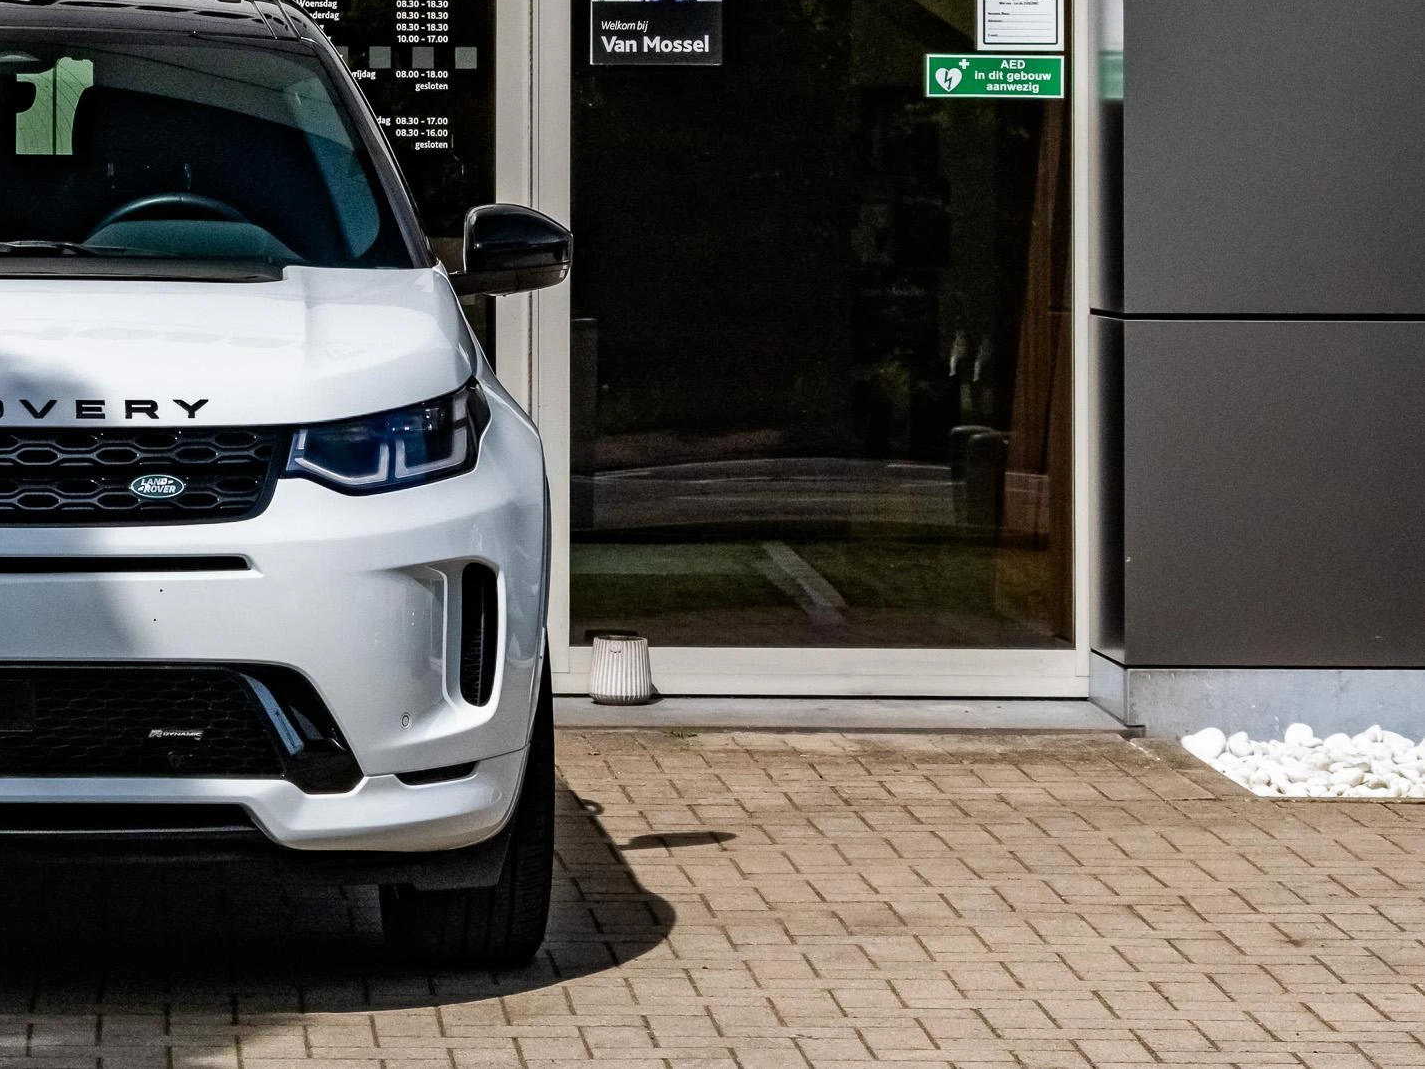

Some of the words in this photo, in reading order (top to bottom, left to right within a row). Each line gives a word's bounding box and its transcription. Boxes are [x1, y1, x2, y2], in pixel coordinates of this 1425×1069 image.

[296, 0, 338, 10] Woensdag
[396, 0, 420, 8] 08.30
[426, 0, 449, 8] 18.30
[396, 12, 420, 20] 08.30
[426, 12, 449, 20] 18.30
[396, 23, 420, 31] 08.30
[426, 23, 449, 31] 18.30
[601, 20, 636, 31] Welkom
[637, 20, 649, 33] bij
[396, 35, 420, 43] 10.00
[426, 35, 449, 43] 17.00
[601, 36, 638, 53] Van
[643, 34, 710, 53] Mossel
[1000, 59, 1026, 70] AED
[396, 71, 420, 79] 08.00
[426, 71, 449, 79] 18.00
[974, 70, 986, 80] in
[988, 70, 1004, 80] dit
[1006, 70, 1052, 83] gebouw
[414, 81, 449, 92] gesloten
[986, 82, 1040, 94] aanwezig
[396, 117, 420, 125] 08.30
[426, 117, 449, 125] 17.00
[396, 129, 420, 137] 08.30
[426, 129, 449, 137] 16.00
[414, 140, 449, 151] gesloten
[141, 478, 168, 486] LAND
[143, 485, 176, 493] ROVER
